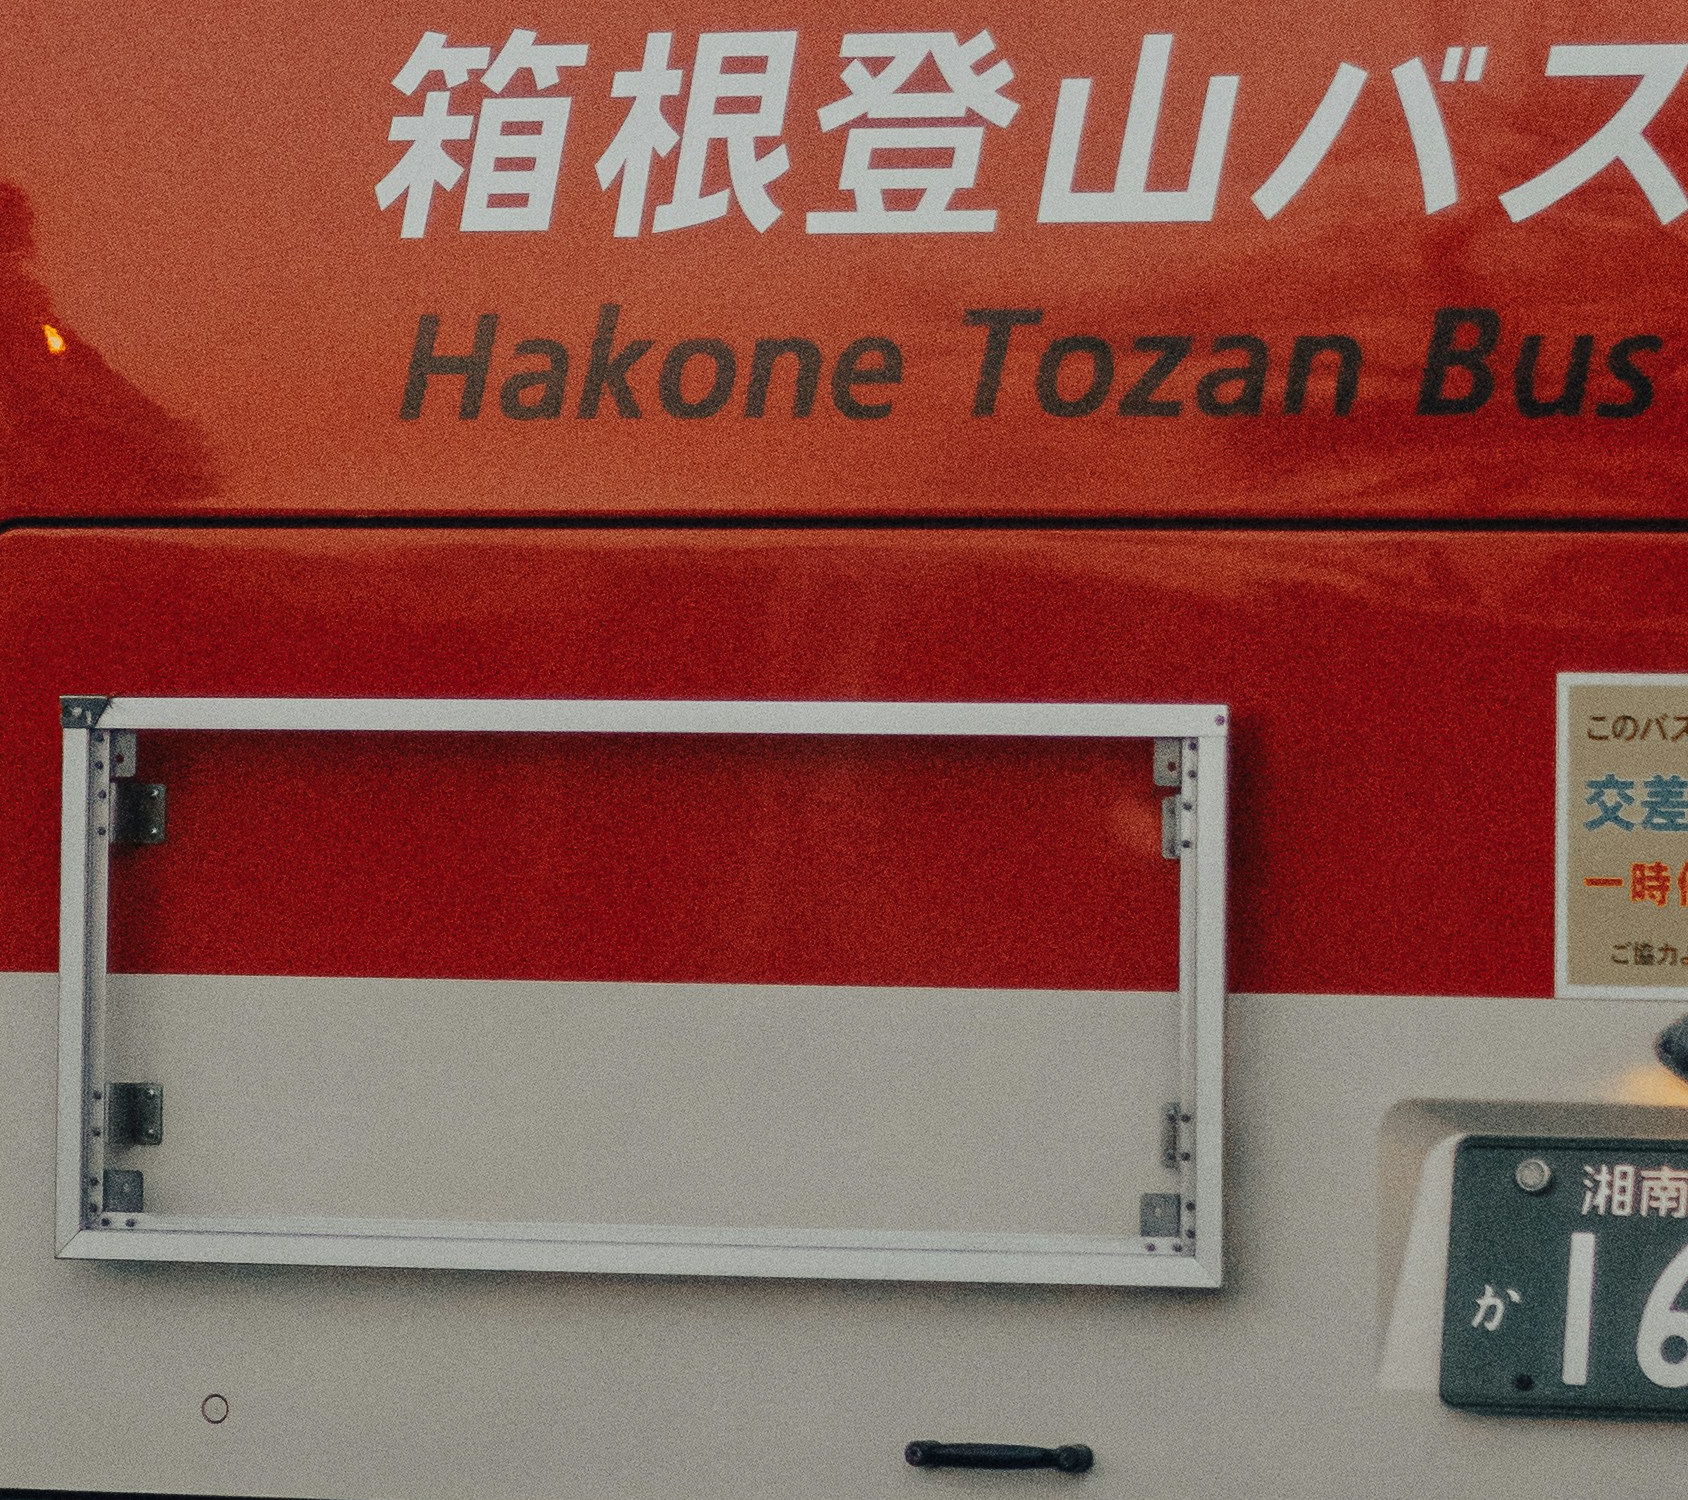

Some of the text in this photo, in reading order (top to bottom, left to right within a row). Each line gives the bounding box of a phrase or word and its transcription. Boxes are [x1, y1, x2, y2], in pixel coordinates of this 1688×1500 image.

[374, 28, 1688, 240] 箱根登山バス
[398, 302, 1664, 421] Hakone Tozan Bus
[1585, 773, 1688, 832] 交差
[1583, 861, 1688, 907] 一時
[1581, 1164, 1688, 1218] 湘南
[1471, 1231, 1688, 1388] か 16
